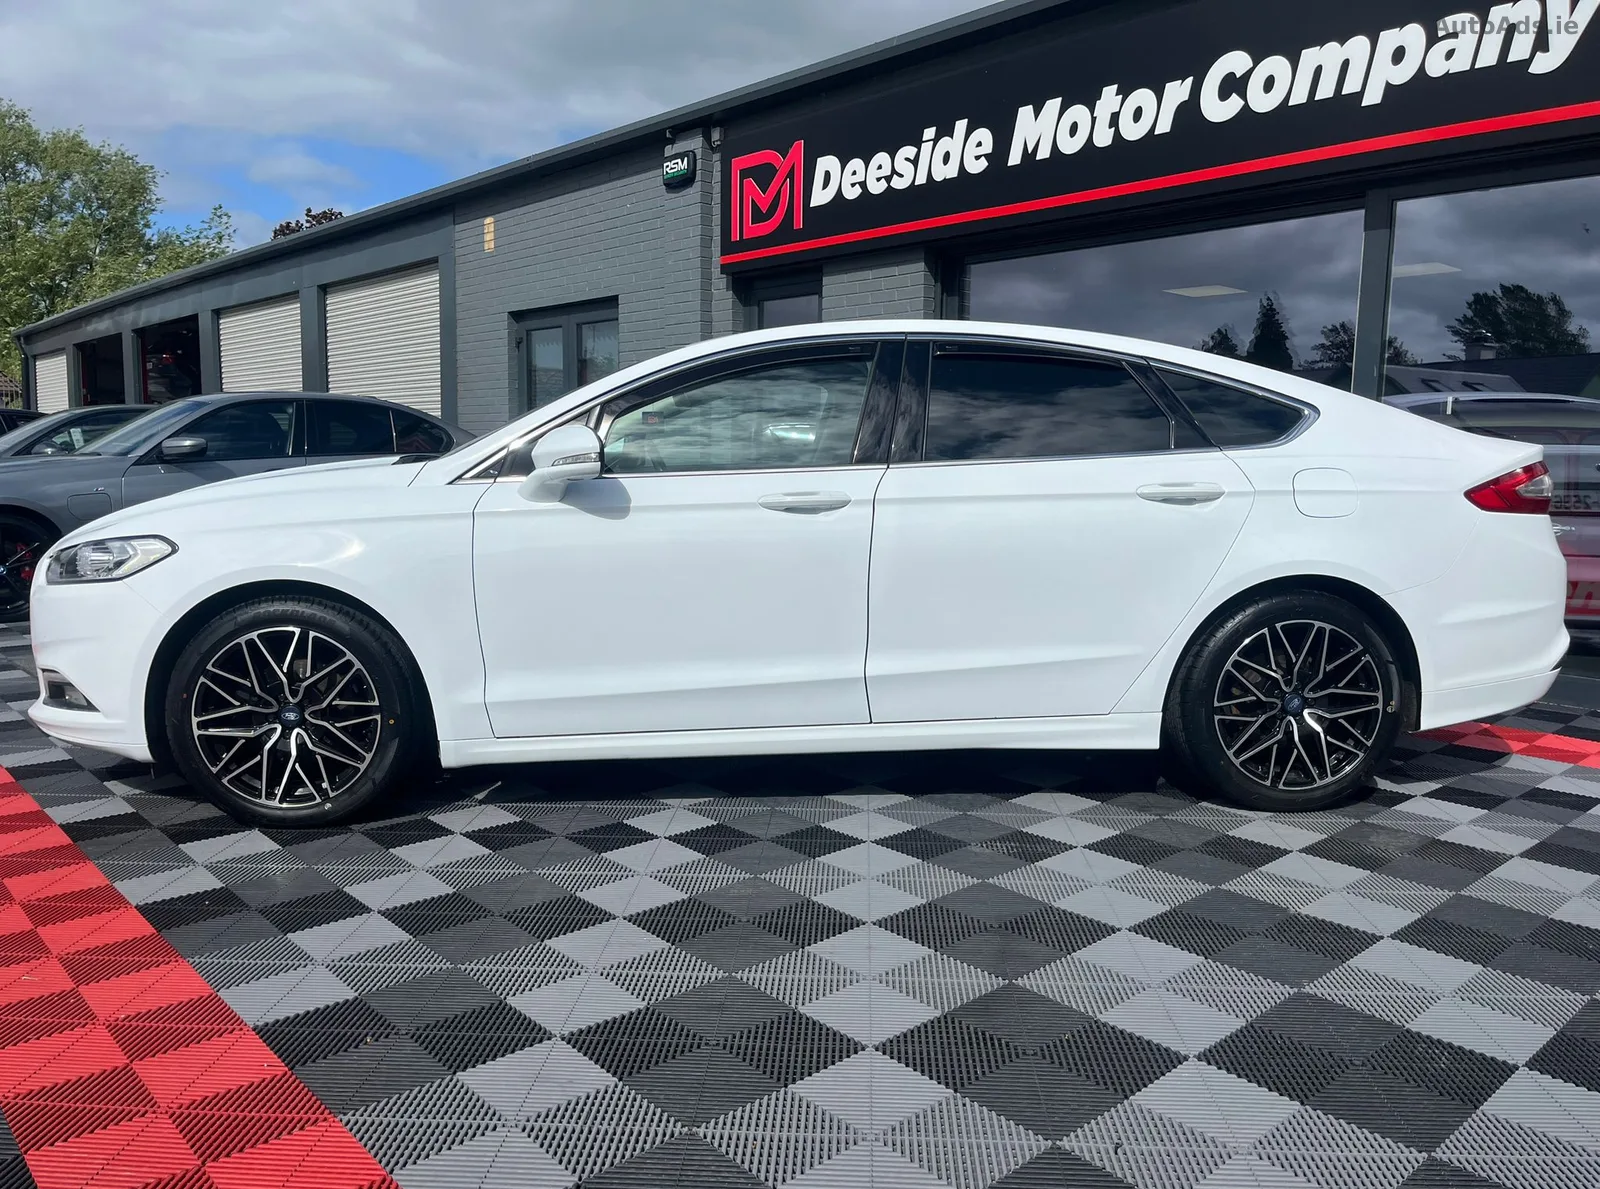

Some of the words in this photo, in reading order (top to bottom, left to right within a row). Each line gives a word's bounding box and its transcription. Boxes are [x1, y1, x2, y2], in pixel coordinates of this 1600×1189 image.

[809, 118, 994, 208] Deeside
[1007, 76, 1194, 167] Motor
[1200, 0, 1600, 124] Company
[663, 156, 688, 175] RSM
